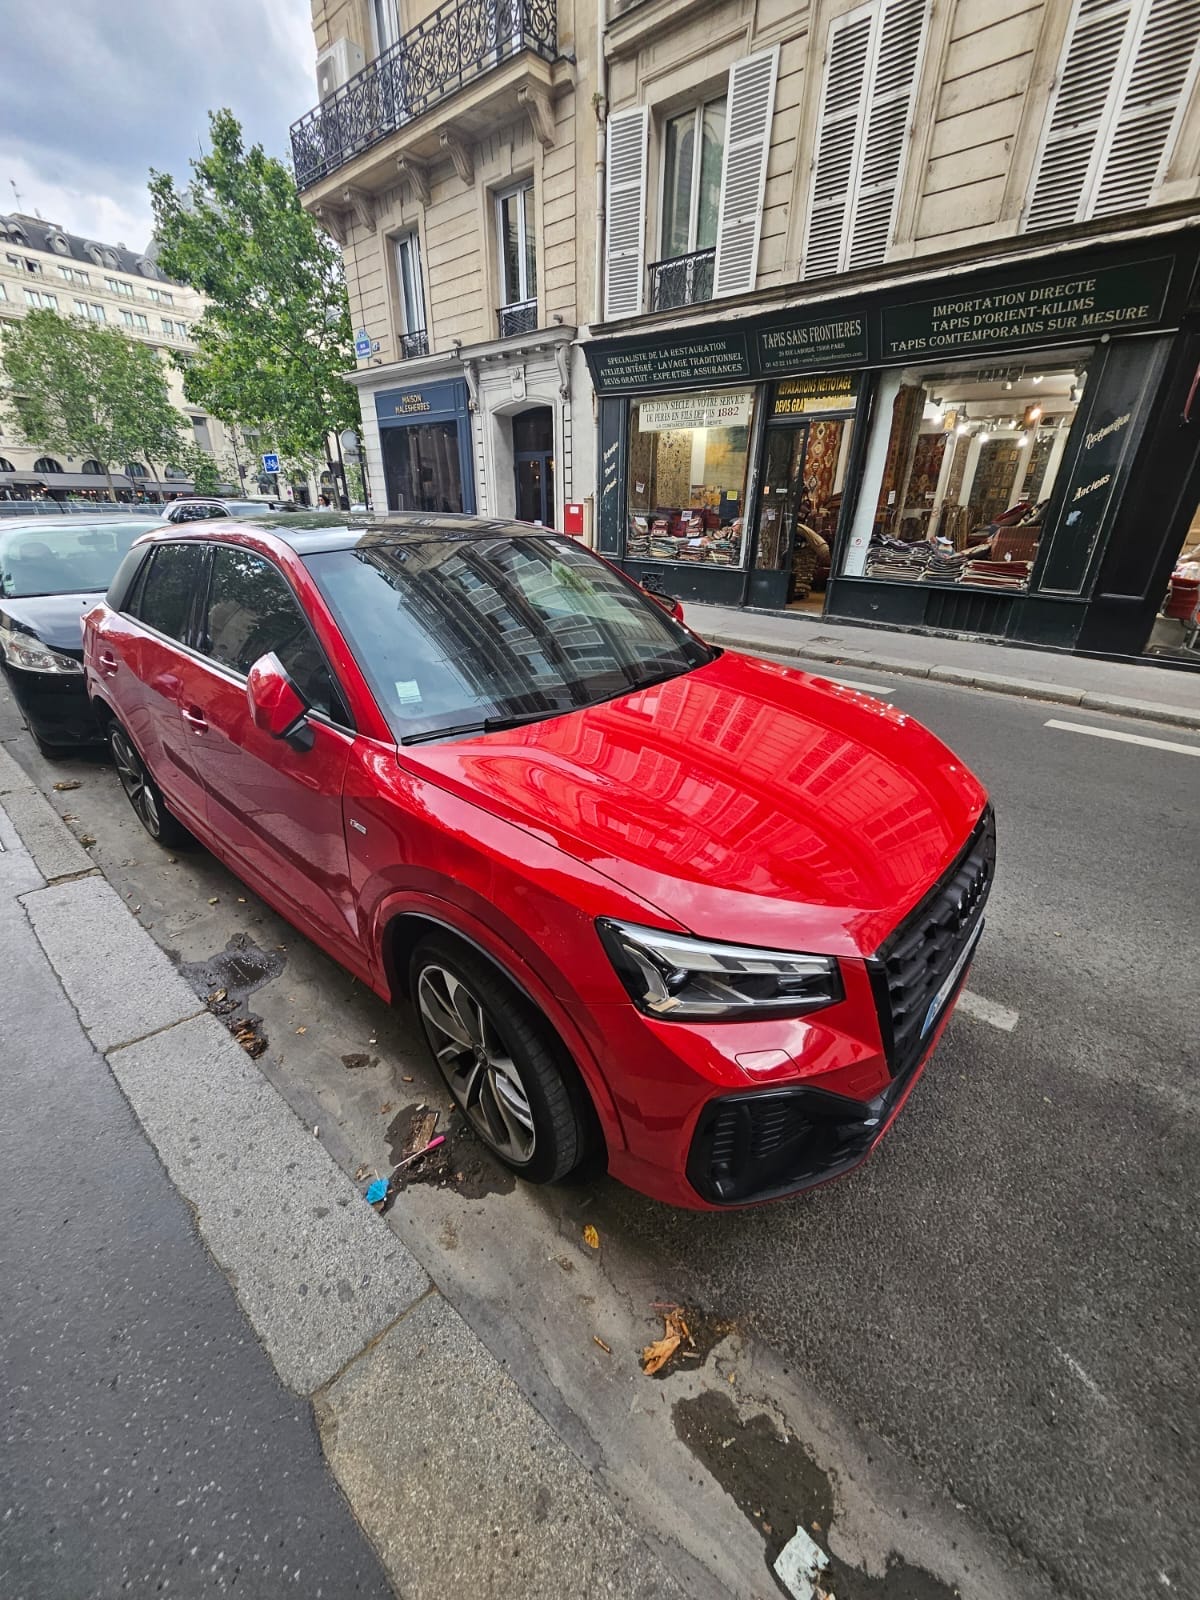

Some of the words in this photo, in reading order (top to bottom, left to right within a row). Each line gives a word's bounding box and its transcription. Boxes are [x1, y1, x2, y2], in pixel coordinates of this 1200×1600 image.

[933, 291, 1026, 318] IMPORTATION
[1029, 279, 1097, 301] DIRECTE
[931, 316, 970, 332] TAPIS
[973, 296, 1095, 327] D'ORIENT-KILIMS
[762, 331, 786, 349] TAPIS
[786, 328, 808, 346] SANS
[809, 319, 862, 343] FRONTIERES
[890, 338, 927, 352] TAPIS
[929, 321, 1044, 347] COMTEMPORAINS
[1047, 316, 1077, 331] SUR
[1081, 305, 1150, 326] MESURE
[600, 366, 625, 376] ATELIER
[657, 358, 688, 370] LAVAGE
[689, 352, 744, 366] TRADITIONNEL
[607, 352, 648, 365] SPECIALISTE
[648, 351, 658, 360] DE
[659, 349, 669, 358] LA
[670, 341, 727, 357] RESTAURATION
[603, 377, 620, 386] DEVIS
[620, 374, 648, 384] GRATUIT
[652, 369, 692, 381] EXPERTISE
[694, 363, 743, 376] ASSURANCES
[718, 406, 739, 417] 1882
[774, 399, 791, 414] DEVIS
